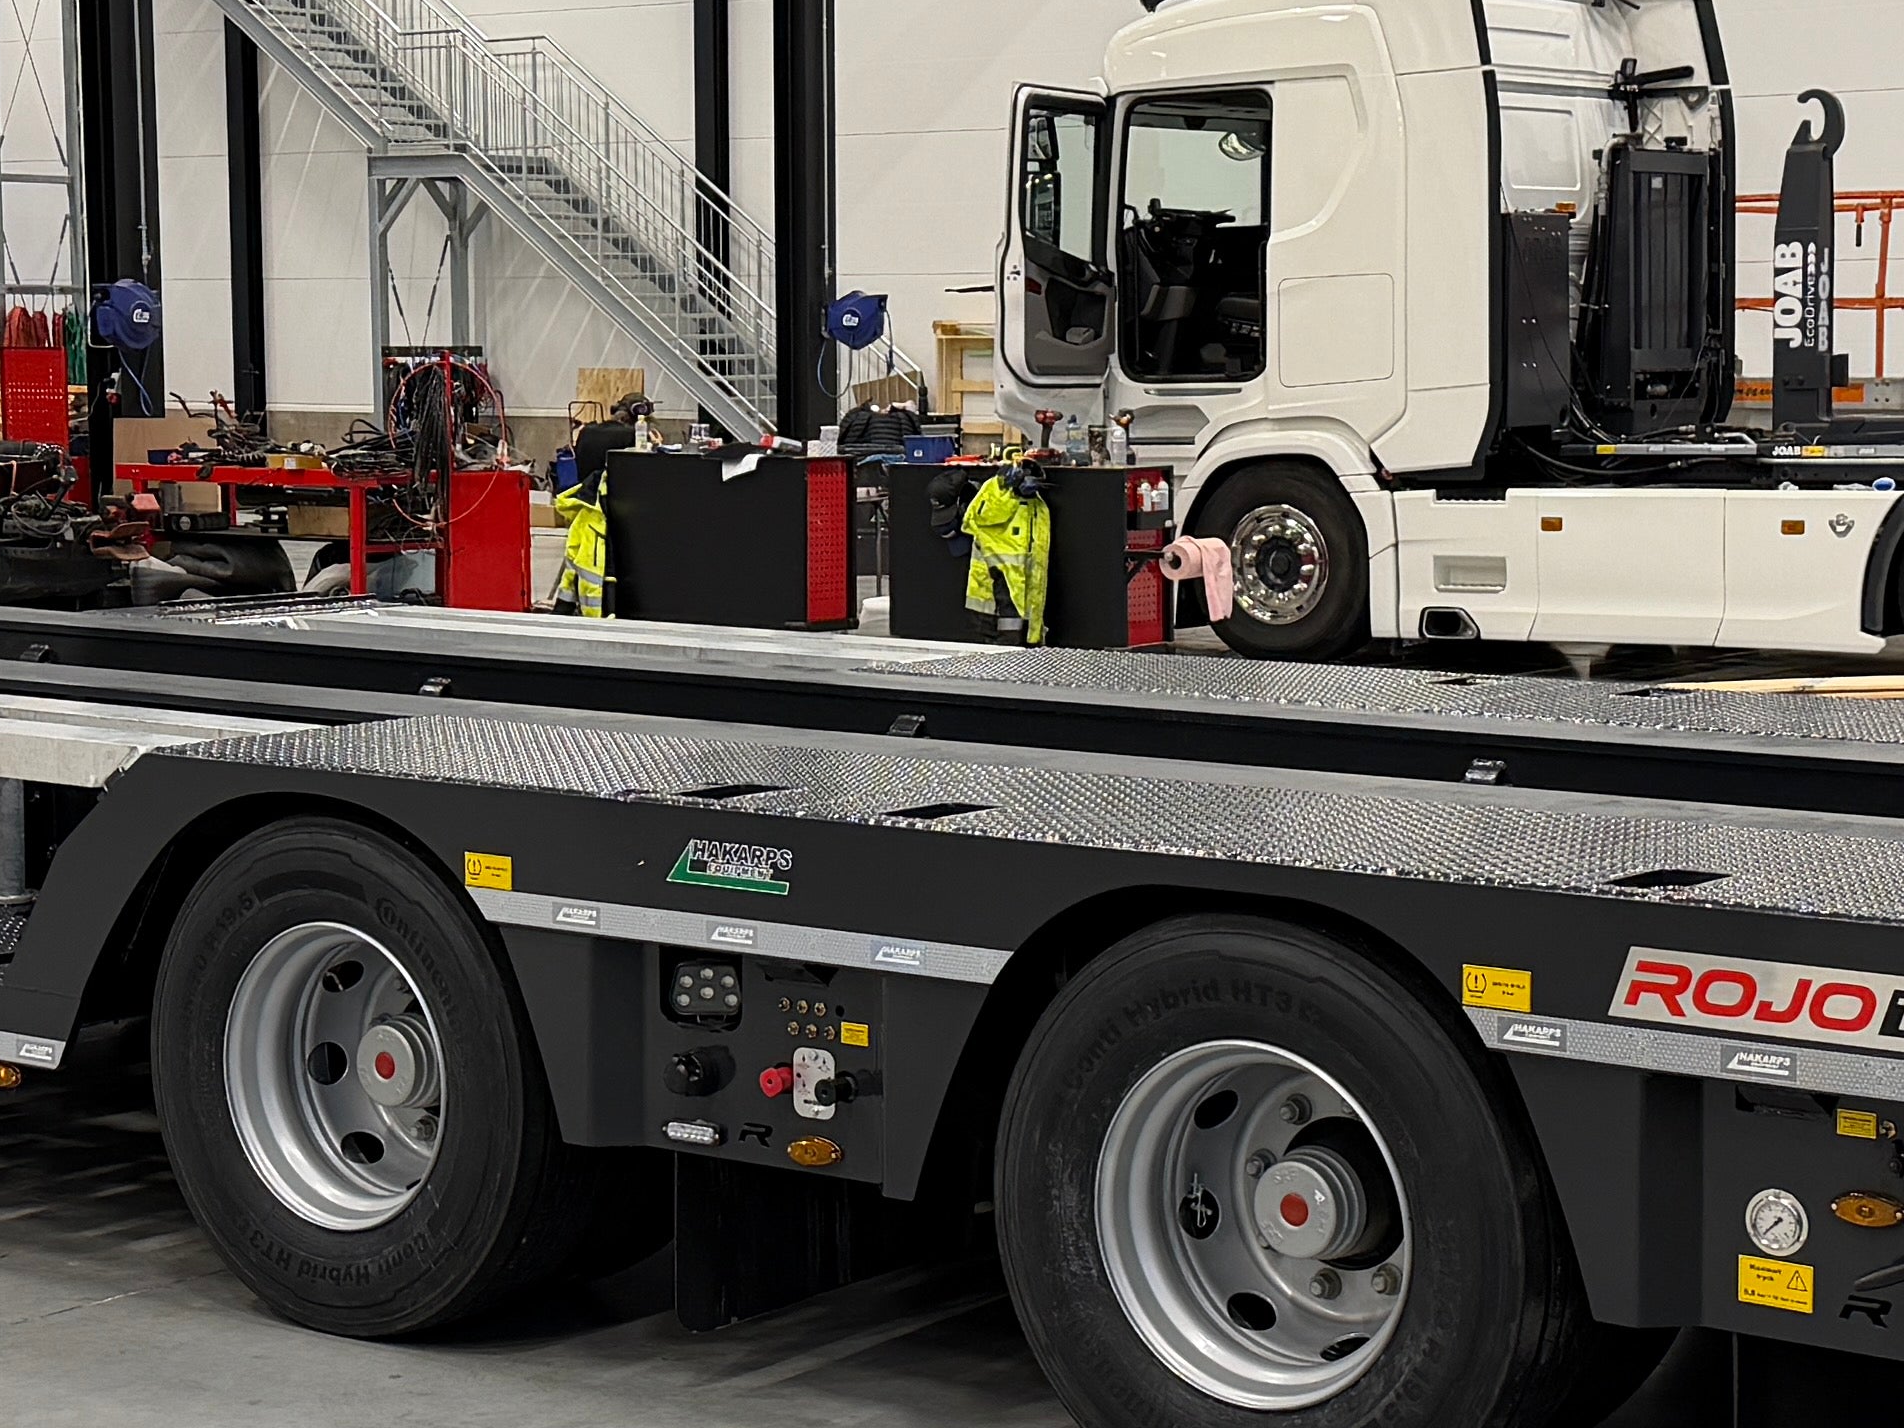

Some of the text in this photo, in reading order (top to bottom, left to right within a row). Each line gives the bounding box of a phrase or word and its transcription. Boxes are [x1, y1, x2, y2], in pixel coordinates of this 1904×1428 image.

[1774, 241, 1804, 348] JOAB
[1804, 275, 1816, 347] EcoDrive
[1772, 445, 1801, 457] JOAB
[688, 838, 793, 870] HAKARPS
[1623, 960, 1877, 1032] ROJO
[1738, 1052, 1791, 1067] HAKARPS
